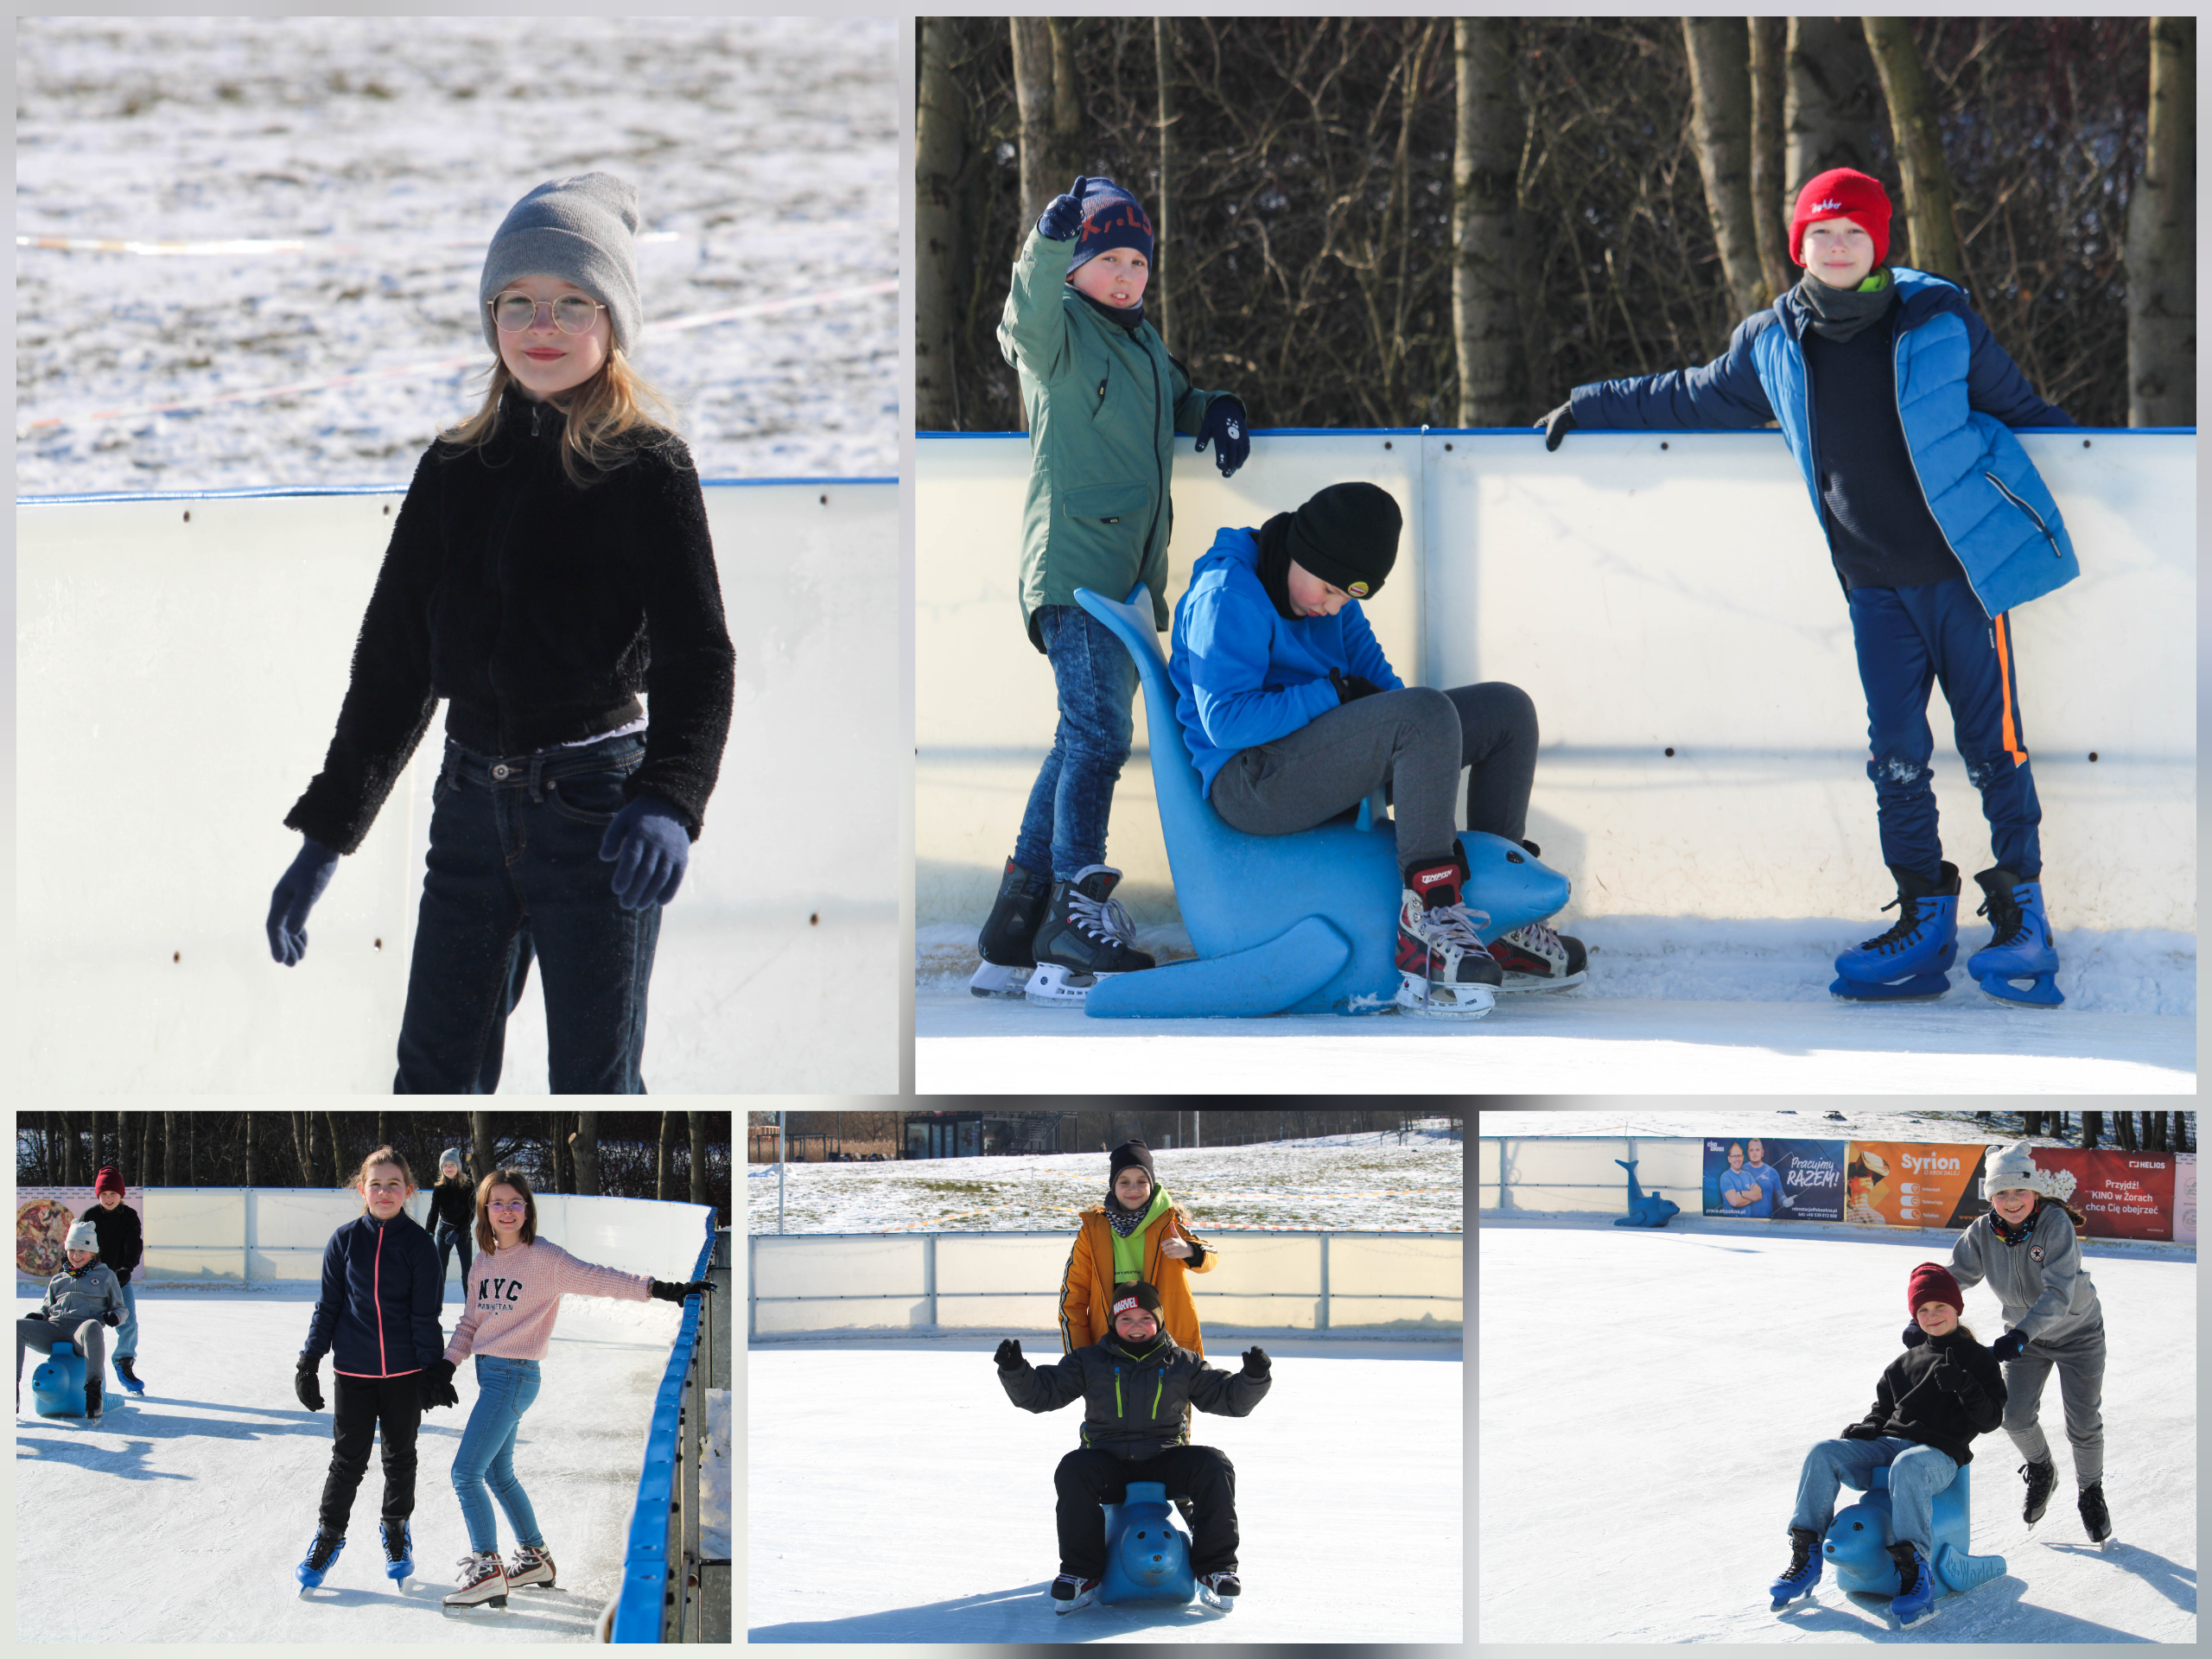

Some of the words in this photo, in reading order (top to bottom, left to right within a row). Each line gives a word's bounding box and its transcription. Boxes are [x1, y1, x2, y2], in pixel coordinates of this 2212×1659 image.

[1791, 1157, 1834, 1176] Pracujmy
[1901, 1151, 1961, 1174] Syrion
[1786, 1169, 1840, 1188] RAZEM!
[2106, 1179, 2139, 1191] Przyjdź!
[2092, 1191, 2113, 1200] KINO
[2124, 1190, 2153, 1202] Żorach
[2085, 1203, 2106, 1211] chce
[2107, 1203, 2120, 1214] Cię
[2122, 1204, 2158, 1215] obejrzeć
[479, 1278, 523, 1301] NYC
[1114, 1297, 1138, 1315] MARVEL
